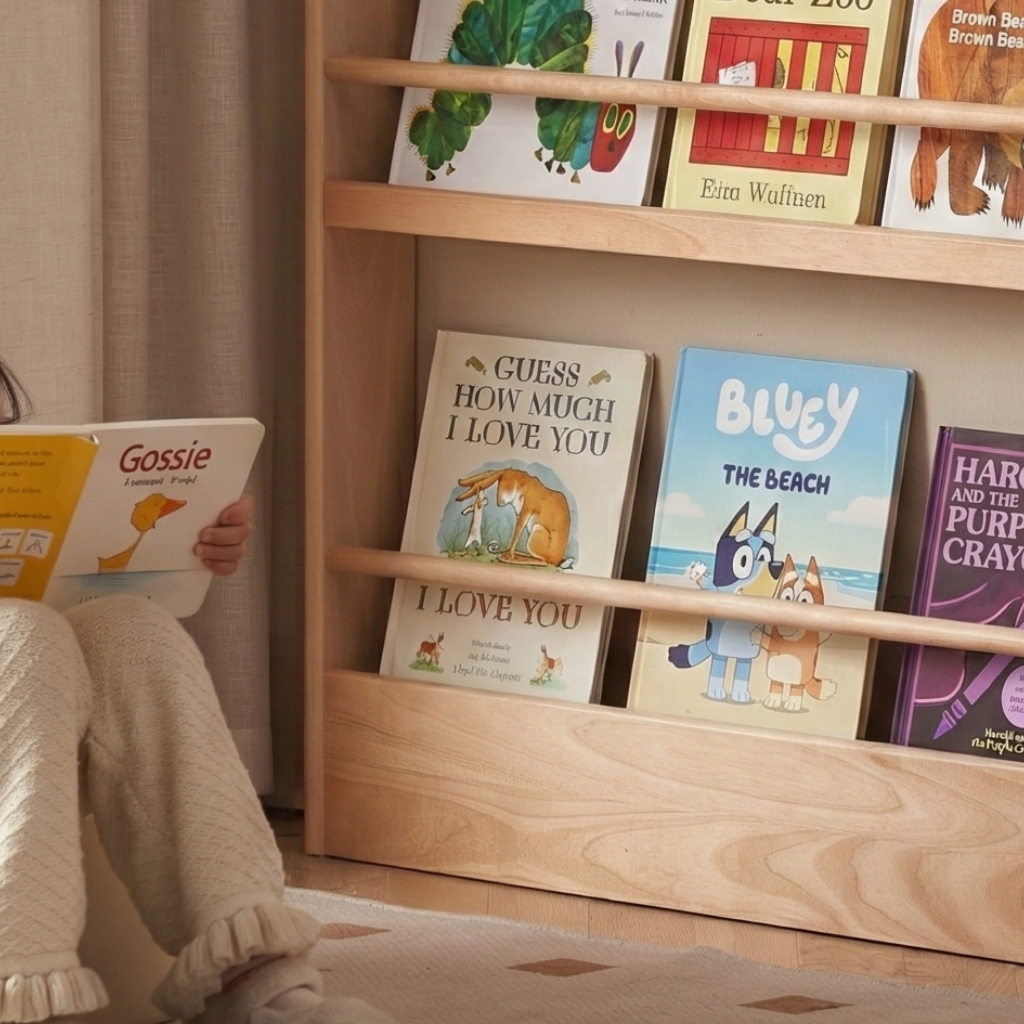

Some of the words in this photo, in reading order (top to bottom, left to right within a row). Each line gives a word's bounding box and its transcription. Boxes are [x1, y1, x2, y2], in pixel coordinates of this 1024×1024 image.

[952, 8, 996, 27] Brown
[494, 355, 581, 388] GUESS
[452, 383, 523, 414] HOW
[527, 391, 616, 424] MUCH
[716, 378, 859, 462] BLUEY
[445, 414, 459, 441] I
[464, 416, 540, 450] LOVE
[550, 426, 611, 457] YOU
[119, 439, 212, 474] Gossie
[723, 463, 761, 488] THE
[765, 468, 831, 495] BEACH
[951, 487, 985, 504] AND
[989, 491, 1019, 508] THE
[415, 585, 429, 611] I
[434, 587, 512, 622] LOVE
[522, 598, 583, 630] YOU
